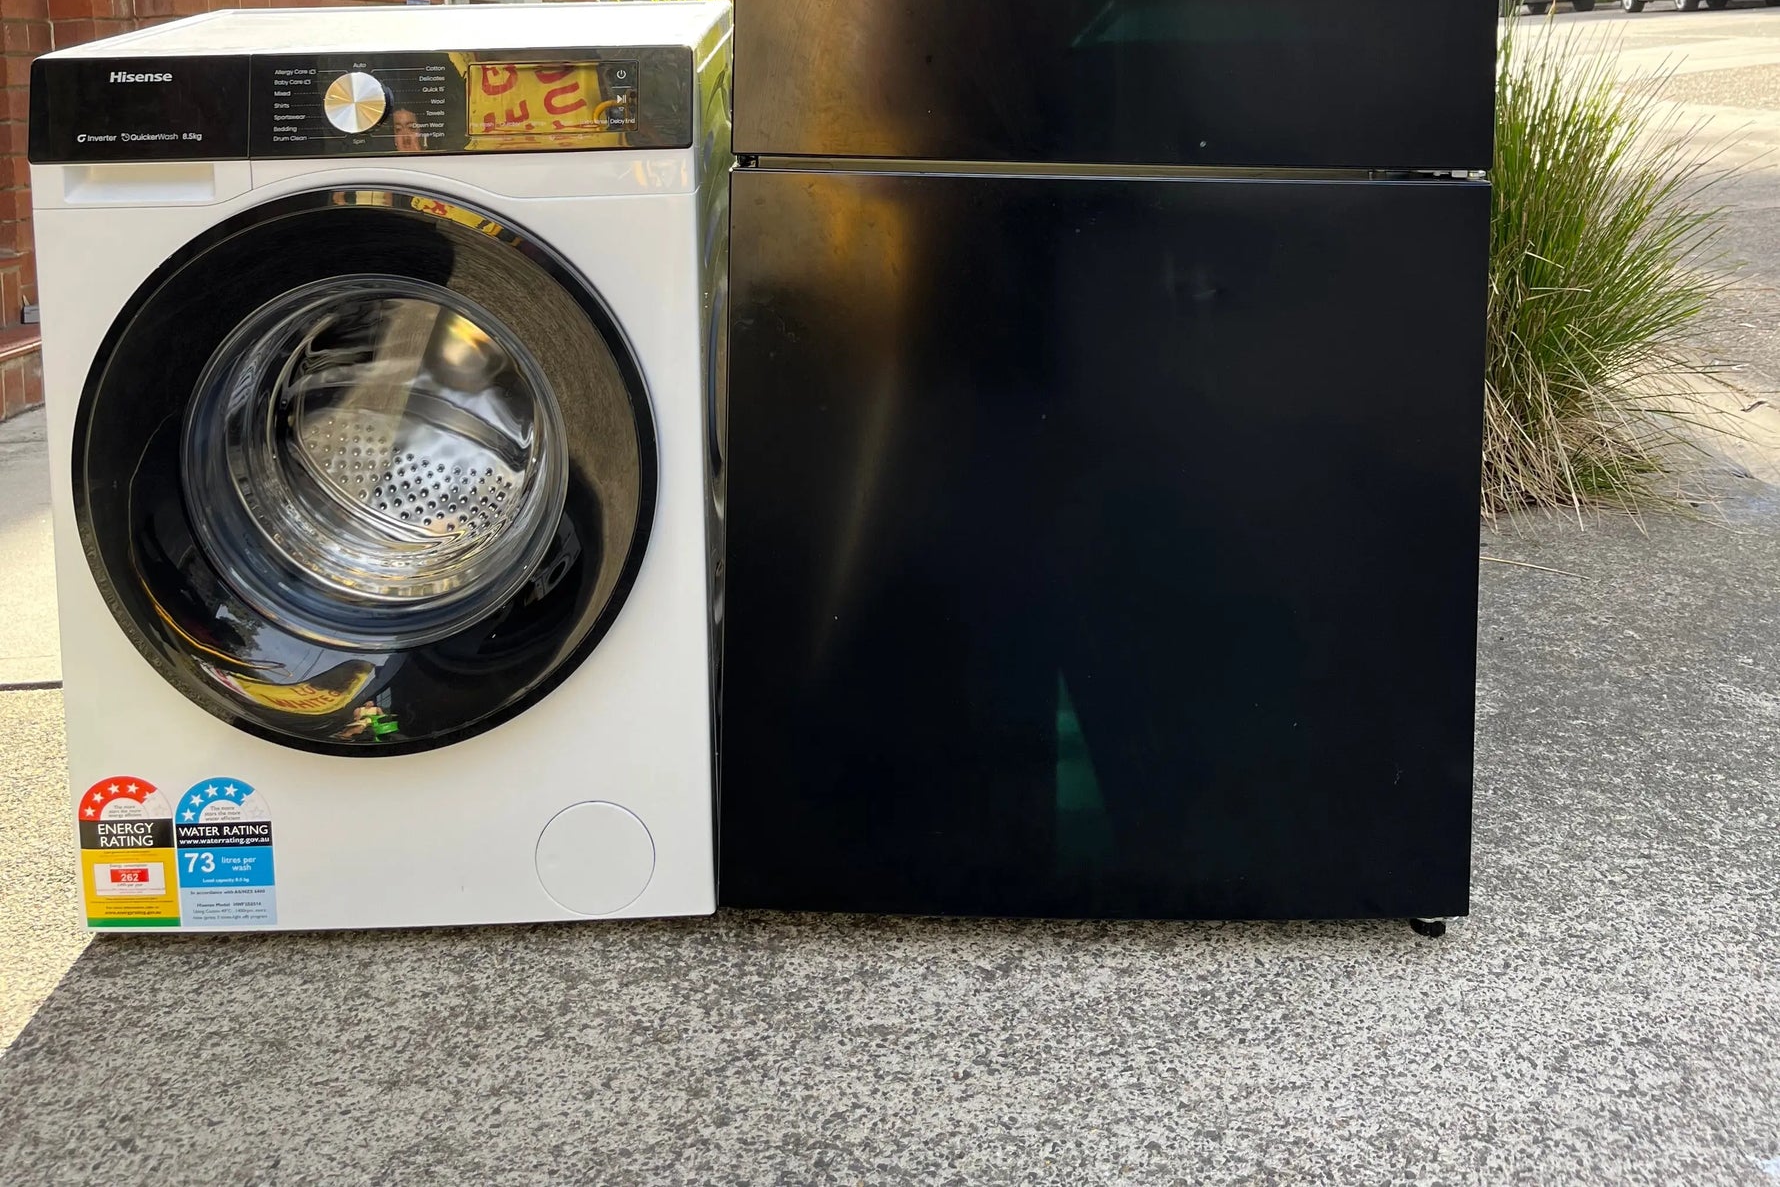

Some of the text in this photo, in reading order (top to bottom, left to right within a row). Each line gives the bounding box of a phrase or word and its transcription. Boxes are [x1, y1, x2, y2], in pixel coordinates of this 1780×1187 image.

[109, 71, 173, 83] Hisense
[87, 134, 117, 142] Inverter
[130, 133, 178, 141] QuickerWash
[97, 822, 154, 835] ENERGY
[178, 825, 268, 837] WATER RATING
[100, 835, 154, 848] RATING
[179, 836, 270, 845] www.waterrating.gov.au
[184, 852, 216, 873] 73
[221, 855, 256, 865] litres per
[120, 873, 139, 882] 262
